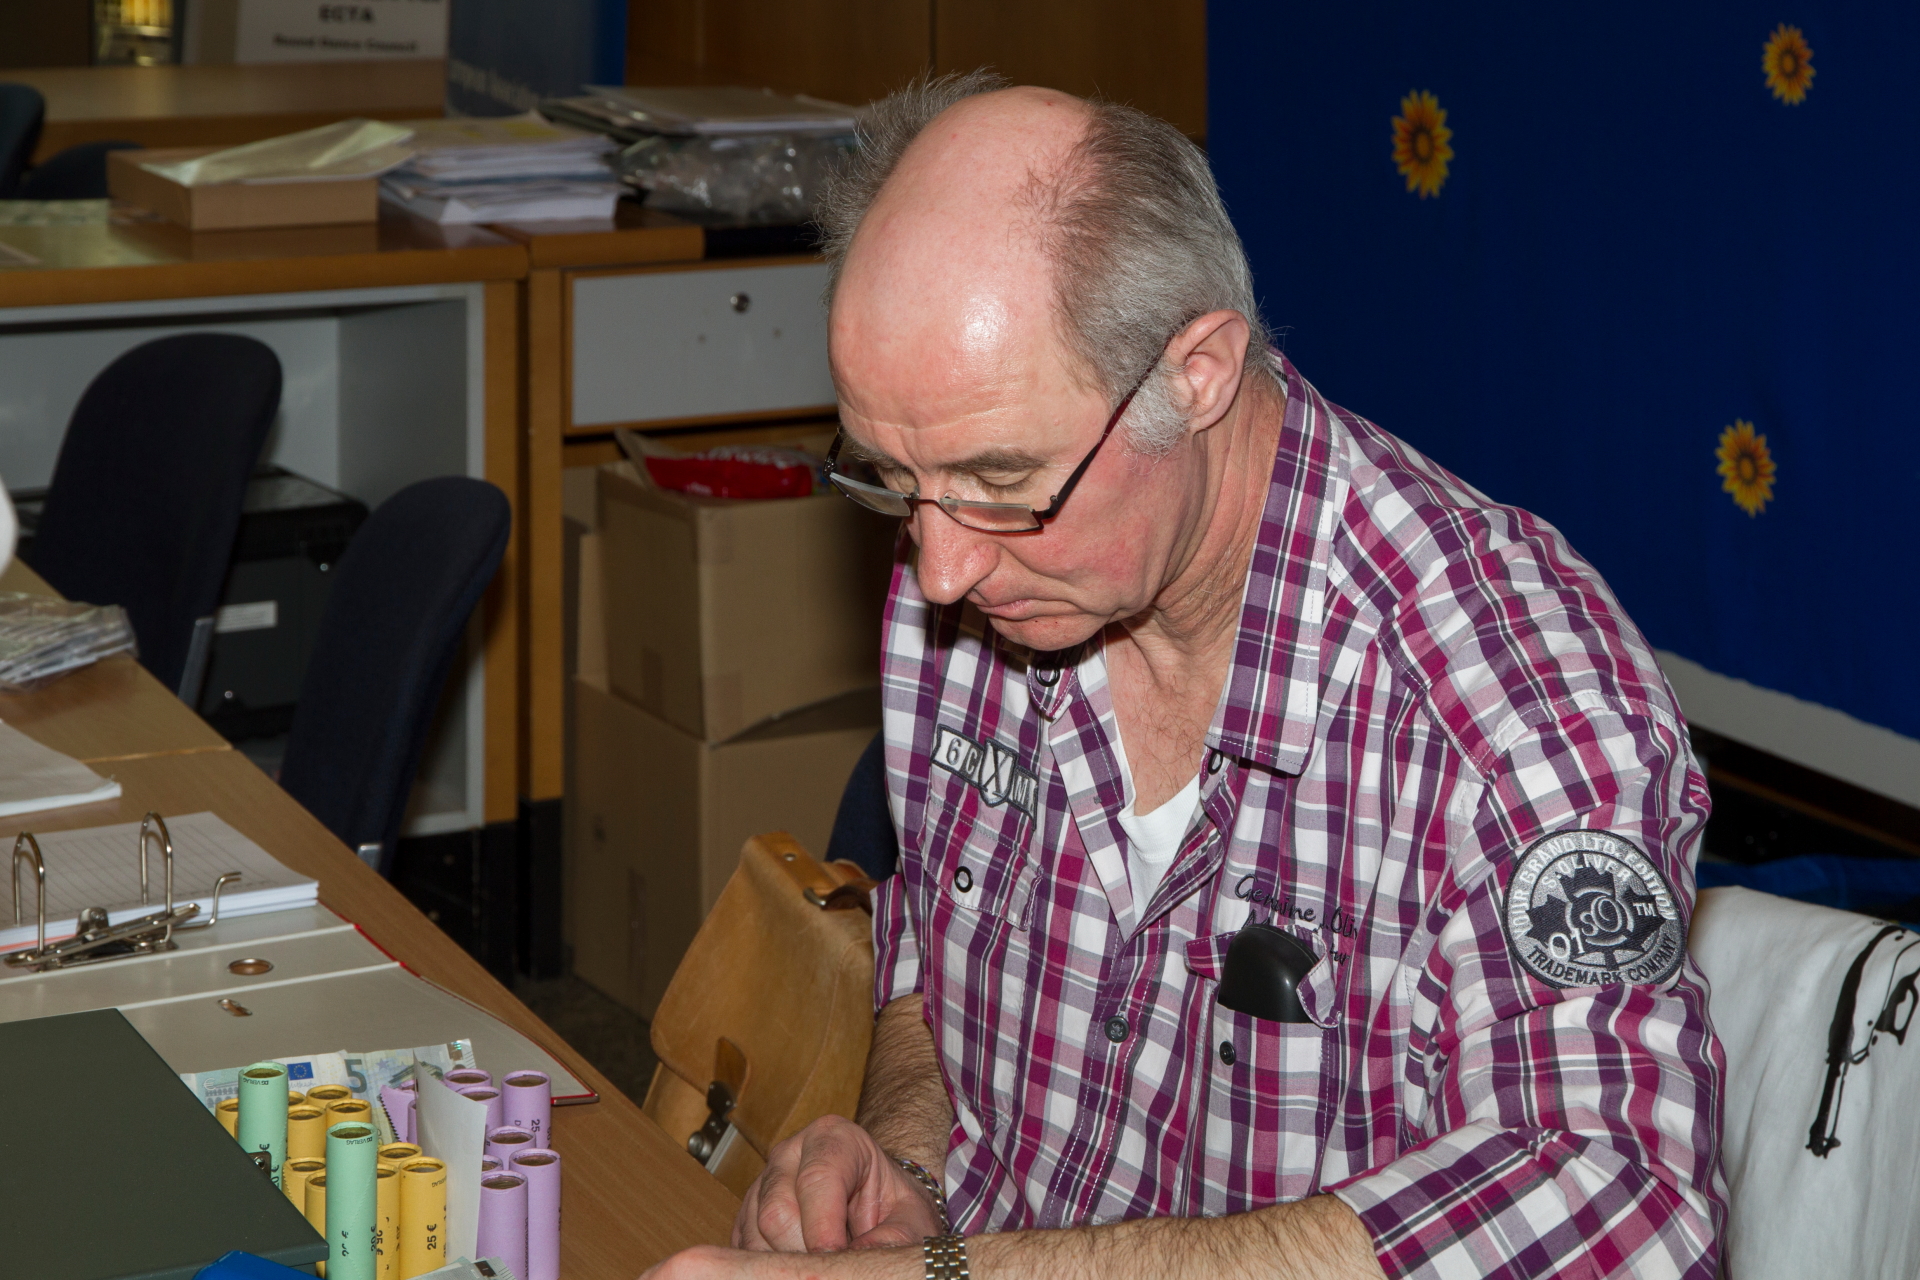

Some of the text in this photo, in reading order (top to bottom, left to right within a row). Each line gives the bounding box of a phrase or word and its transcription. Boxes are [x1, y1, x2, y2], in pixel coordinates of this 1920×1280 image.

[319, 5, 374, 22] ECTA
[274, 34, 418, 52] Round Dance Council
[1513, 836, 1678, 940] YOUR GRAND LTD. EDITION
[1235, 873, 1316, 922] Genuine
[1633, 902, 1656, 917] TM
[1527, 934, 1678, 985] TRADEMARK COMPANY
[345, 1058, 368, 1094] 5
[531, 1119, 540, 1132] 25
[427, 1235, 437, 1250] 25
